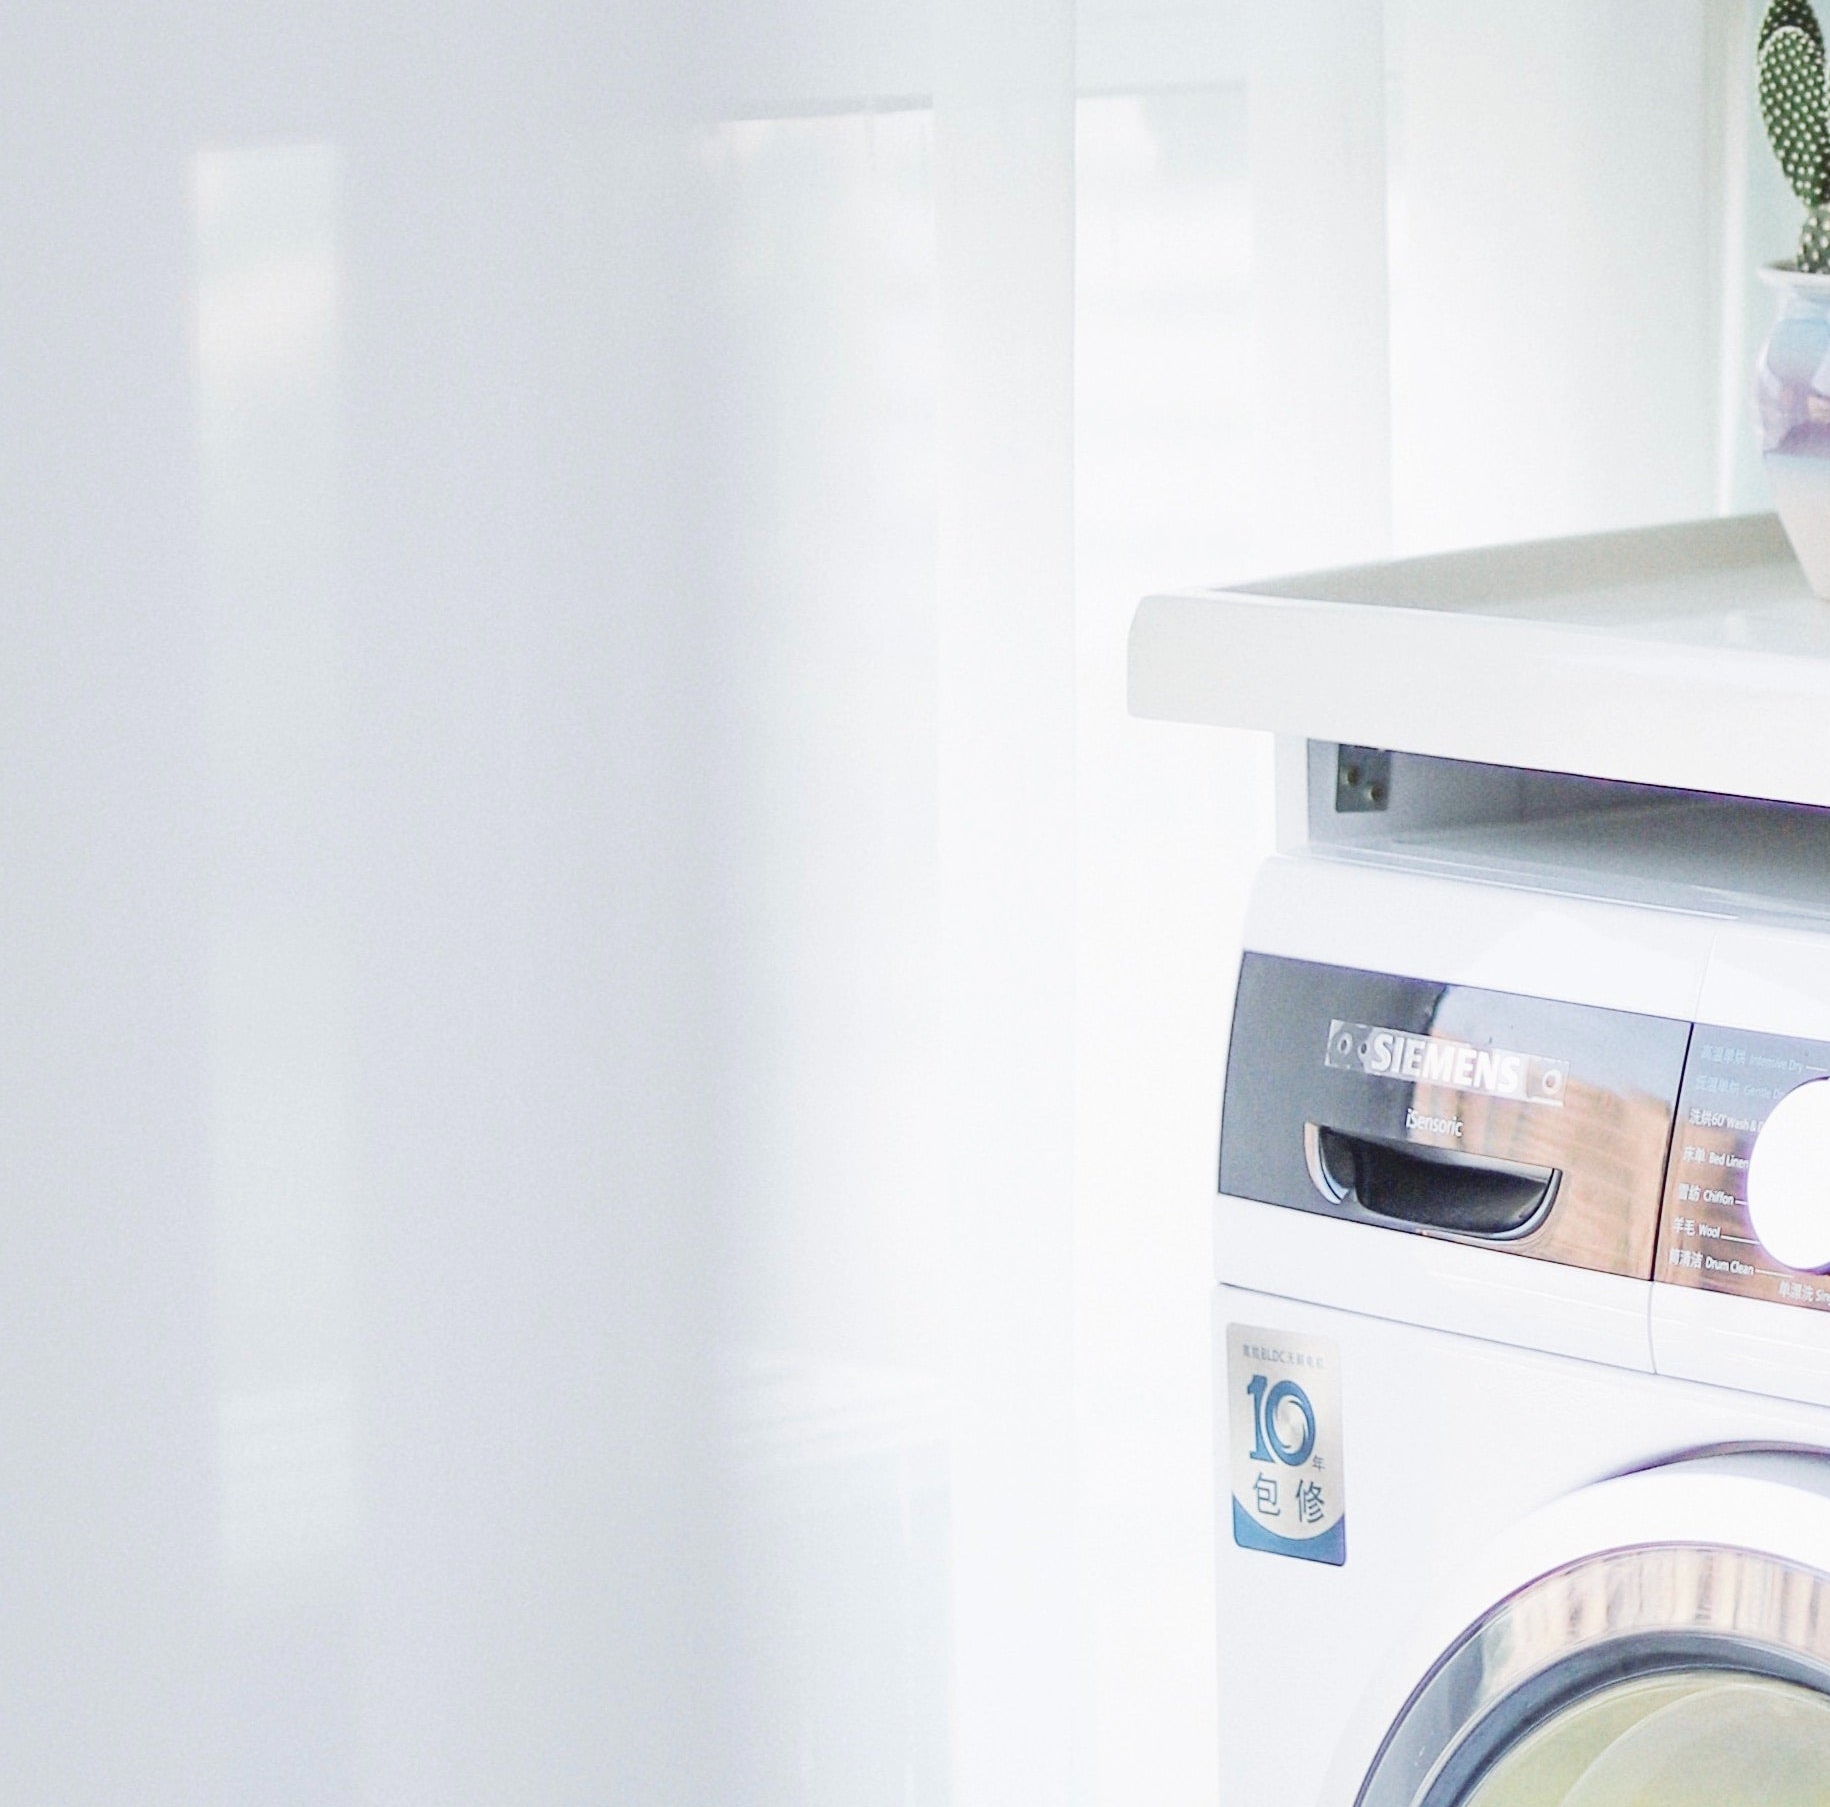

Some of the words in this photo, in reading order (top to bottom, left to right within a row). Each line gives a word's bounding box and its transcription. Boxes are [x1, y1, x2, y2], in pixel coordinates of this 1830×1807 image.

[1370, 1032, 1521, 1094] SIEMENS
[1750, 1055, 1787, 1069] Intensive
[1788, 1060, 1804, 1074] Dry
[1406, 1108, 1464, 1138] iSensoric
[1683, 1145, 1706, 1163] 床单
[1709, 1153, 1726, 1167] Bed
[1726, 1155, 1750, 1169] Linen
[1703, 1190, 1735, 1206] Chiffon
[1674, 1216, 1696, 1236] 羊毛
[1699, 1224, 1721, 1238] Wool
[1705, 1257, 1730, 1272] Drum
[1730, 1261, 1755, 1276] Clean
[1253, 1472, 1325, 1524] 包修
